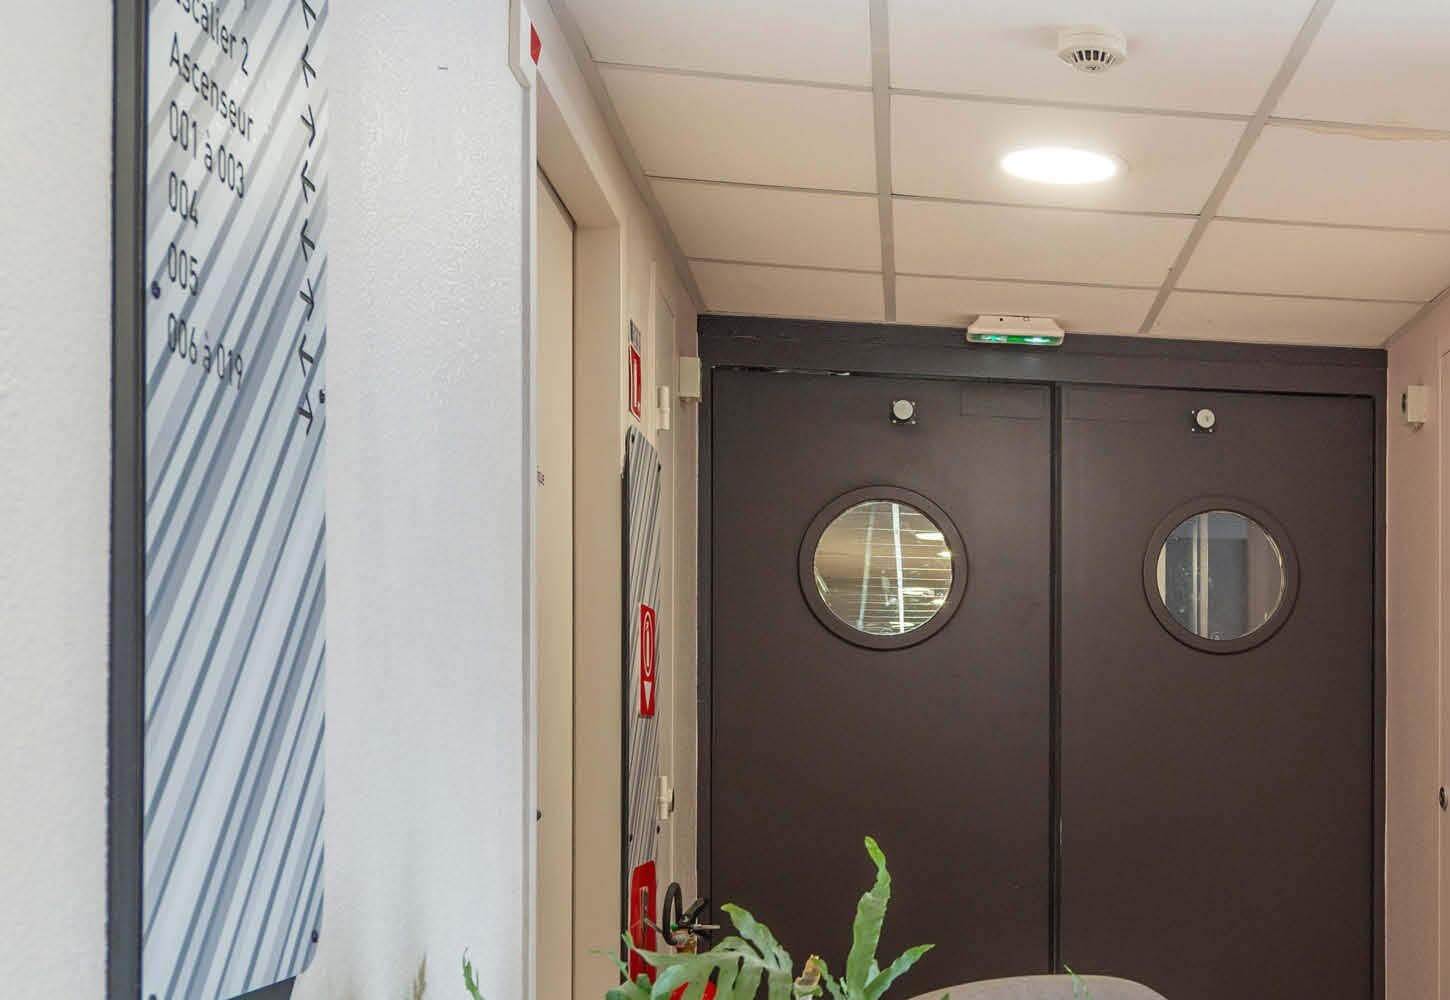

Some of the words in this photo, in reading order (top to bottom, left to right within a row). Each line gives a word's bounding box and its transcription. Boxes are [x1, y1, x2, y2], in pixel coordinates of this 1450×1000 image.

[169, 32, 254, 144] Ascenseur
[241, 36, 249, 77] 2
[168, 100, 199, 160] 001
[204, 129, 214, 173] à
[216, 143, 245, 200] 003
[167, 171, 199, 229] 004
[167, 241, 199, 298] 005
[167, 312, 198, 366] 006
[201, 330, 212, 375] à
[216, 342, 244, 391] 019
